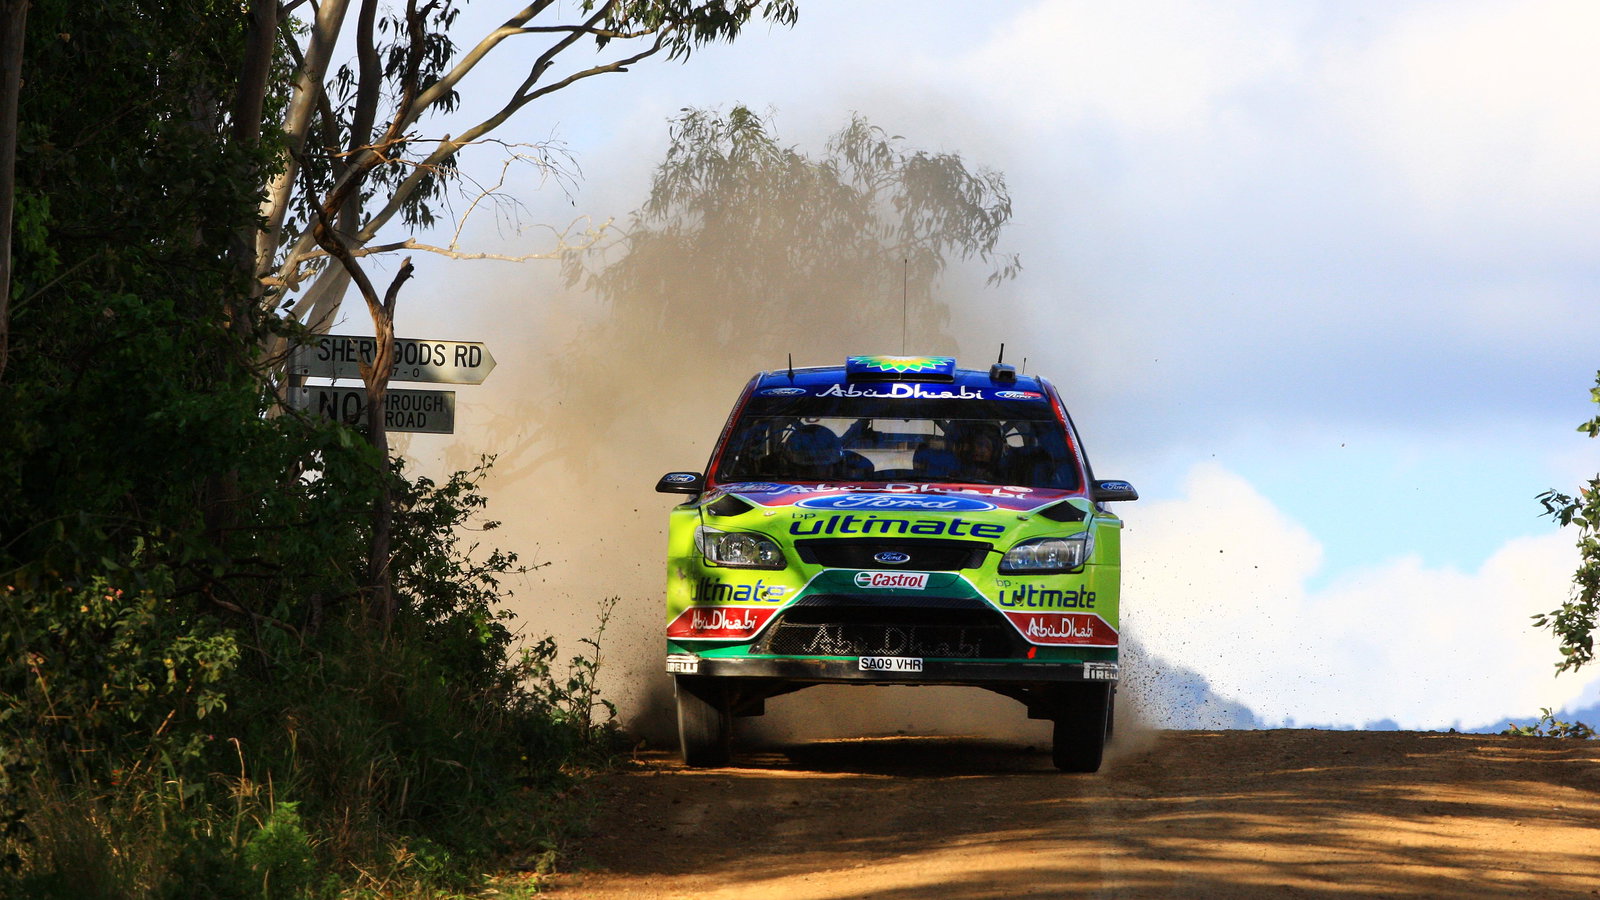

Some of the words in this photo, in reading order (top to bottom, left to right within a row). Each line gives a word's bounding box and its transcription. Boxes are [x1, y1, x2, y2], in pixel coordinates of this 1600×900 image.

[317, 337, 446, 367] SHEROODS
[454, 344, 483, 368] RD
[319, 391, 362, 425] NO
[384, 411, 427, 428] ROAD
[832, 495, 958, 510] Ford
[788, 515, 1006, 539] ultimate
[690, 577, 786, 602] ultimate
[872, 573, 924, 588] Castrol
[999, 584, 1096, 609] ultimate
[860, 658, 893, 670] SA09
[896, 659, 923, 671] VHR
